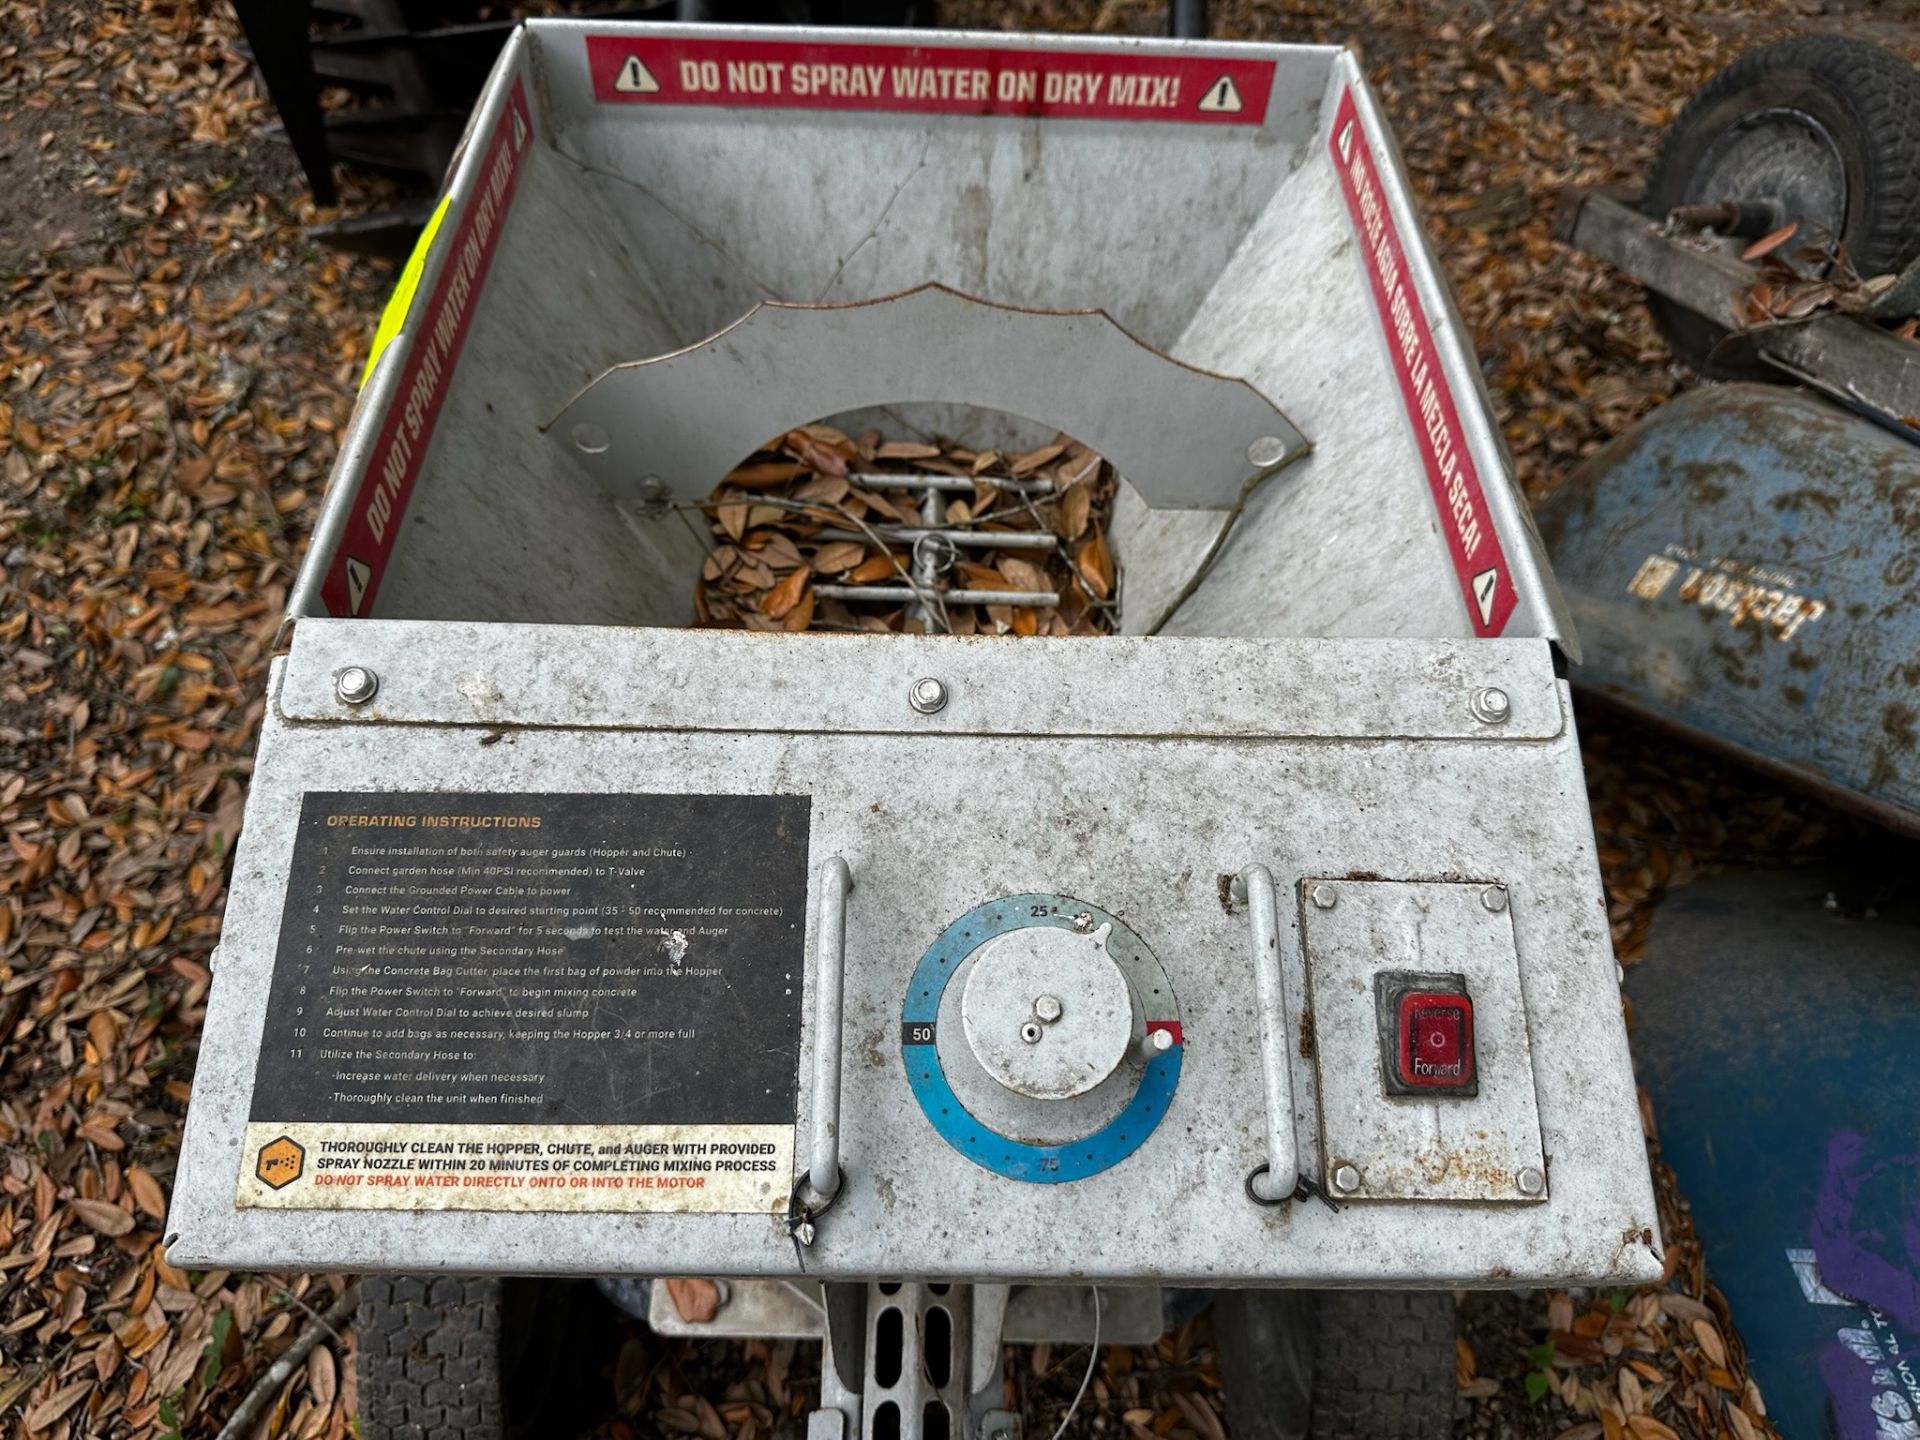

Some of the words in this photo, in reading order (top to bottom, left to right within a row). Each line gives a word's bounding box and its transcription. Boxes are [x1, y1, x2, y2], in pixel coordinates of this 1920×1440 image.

[680, 60, 720, 92] DO
[726, 61, 784, 94] NOT
[790, 64, 885, 97] SPRAY
[891, 66, 991, 100] WATER
[997, 70, 1036, 101] ON
[1043, 72, 1104, 104] DRY
[1107, 74, 1181, 108] MIX!
[366, 483, 391, 545] DO
[383, 422, 413, 499] NOT
[405, 337, 438, 440] SPRAY
[434, 259, 471, 355] WATER
[464, 228, 481, 279] ON
[475, 186, 496, 249] DRY
[1390, 284, 1420, 367] SOBRE
[1410, 351, 1428, 396] LA
[1419, 378, 1457, 486] MEZCLA
[1448, 471, 1482, 561] SECA!
[327, 815, 417, 828] OPERATING
[421, 816, 542, 829] INSTRUCTIONS
[352, 847, 385, 855] Ensure
[389, 847, 444, 856] installation
[520, 849, 549, 858] auger
[552, 849, 586, 858] guards
[589, 848, 631, 858] (Hopper
[632, 849, 651, 857] and
[653, 848, 686, 858] Chute)
[348, 866, 390, 876] Connect
[392, 867, 428, 877] garden
[430, 867, 455, 876] hose
[595, 868, 606, 876] to
[608, 867, 645, 876] T-Valve
[345, 886, 387, 895] Connect
[390, 886, 405, 895] the
[409, 886, 458, 895] Grounded
[460, 886, 491, 895] Power
[527, 887, 537, 896] to
[540, 888, 571, 896] power
[312, 905, 319, 913] 4
[342, 905, 359, 914] Set
[362, 905, 378, 914] the
[381, 906, 411, 914] Water
[413, 905, 450, 915] Control
[453, 906, 472, 915] Dial
[489, 906, 527, 915] desired
[572, 906, 598, 916] point
[628, 907, 641, 915] 50
[644, 907, 716, 916] recommended
[718, 907, 733, 916] for
[736, 907, 784, 917] concrete)
[1030, 905, 1048, 917] 25
[339, 925, 358, 935] Flip
[360, 926, 377, 934] the
[379, 926, 411, 935] Power
[414, 926, 448, 935] Switch
[519, 926, 534, 935] for
[604, 927, 624, 935] test
[627, 927, 643, 936] the
[698, 927, 728, 936] Auger
[306, 946, 313, 955] 6
[378, 946, 395, 955] the
[398, 946, 426, 955] chute
[429, 947, 457, 957] using
[460, 947, 478, 955] the
[480, 947, 534, 956] Secondary
[537, 947, 564, 955] Hose
[384, 966, 430, 976] Concrete
[433, 967, 452, 978] Bag
[523, 967, 540, 976] the
[543, 967, 565, 976] first
[567, 967, 586, 978] bag
[589, 967, 600, 976] of
[603, 968, 640, 978] powder
[685, 968, 722, 978] Hopper
[329, 986, 348, 997] Flip
[351, 987, 368, 995] the
[371, 987, 402, 996] Power
[405, 987, 440, 997] Switch
[522, 988, 551, 998] begin
[554, 989, 589, 998] mixing
[326, 1008, 360, 1017] Adjust
[363, 1008, 392, 1017] Water
[395, 1008, 433, 1017] Control
[436, 1008, 456, 1017] Dial
[472, 1008, 513, 1017] achieve
[515, 1009, 554, 1018] desired
[557, 1009, 589, 1019] slump
[294, 1028, 307, 1037] 10
[323, 1028, 369, 1038] Continue
[385, 1029, 405, 1038] add
[509, 1029, 550, 1041] keeping
[553, 1029, 570, 1039] the
[573, 1029, 611, 1041] Hopper
[648, 1031, 676, 1039] more
[678, 1029, 695, 1039] full
[912, 1027, 931, 1041] 50
[290, 1049, 302, 1058] 11
[320, 1049, 353, 1059] Utilize
[356, 1050, 372, 1059] the
[375, 1050, 430, 1061] Secondary
[433, 1051, 460, 1060] Hose
[1414, 1057, 1461, 1076] Forward
[332, 1072, 381, 1081] -Increase
[384, 1072, 412, 1081] water
[416, 1072, 457, 1083] delivery
[460, 1072, 488, 1082] when
[491, 1073, 545, 1083] necessary
[328, 1093, 392, 1104] -Thoroughly
[395, 1093, 425, 1103] clean
[427, 1094, 444, 1103] the
[446, 1094, 467, 1103] unit
[469, 1094, 497, 1103] when
[500, 1094, 544, 1103] finished
[320, 1141, 408, 1154] THOROUGHLY
[411, 1142, 454, 1154] CLEAN
[457, 1143, 483, 1155] THE
[486, 1143, 543, 1156] HOPPER,
[547, 1143, 595, 1156] CHUTE,
[598, 1144, 621, 1155] and
[624, 1144, 669, 1155] AUGER
[672, 1144, 706, 1155] WITH
[710, 1144, 776, 1155] PROVIDED
[317, 1158, 360, 1169] SPRAY
[363, 1159, 415, 1170] NOZZLE
[418, 1159, 467, 1170] WITHIN
[469, 1160, 486, 1170] 20
[489, 1160, 549, 1171] MINUTES
[552, 1160, 570, 1171] OF
[574, 1160, 660, 1172] COMPLETING
[663, 1160, 712, 1172] MIXING
[715, 1160, 777, 1172] PROCESS
[315, 1175, 334, 1186] DO
[336, 1175, 363, 1186] NOT
[367, 1175, 411, 1186] SPRAY
[414, 1176, 459, 1187] WATER
[463, 1176, 526, 1188] DIRECTLY
[529, 1177, 566, 1188] ONTO
[570, 1177, 588, 1188] OR
[592, 1177, 625, 1188] INTO
[628, 1177, 654, 1188] THE
[657, 1177, 705, 1188] MOTOR
